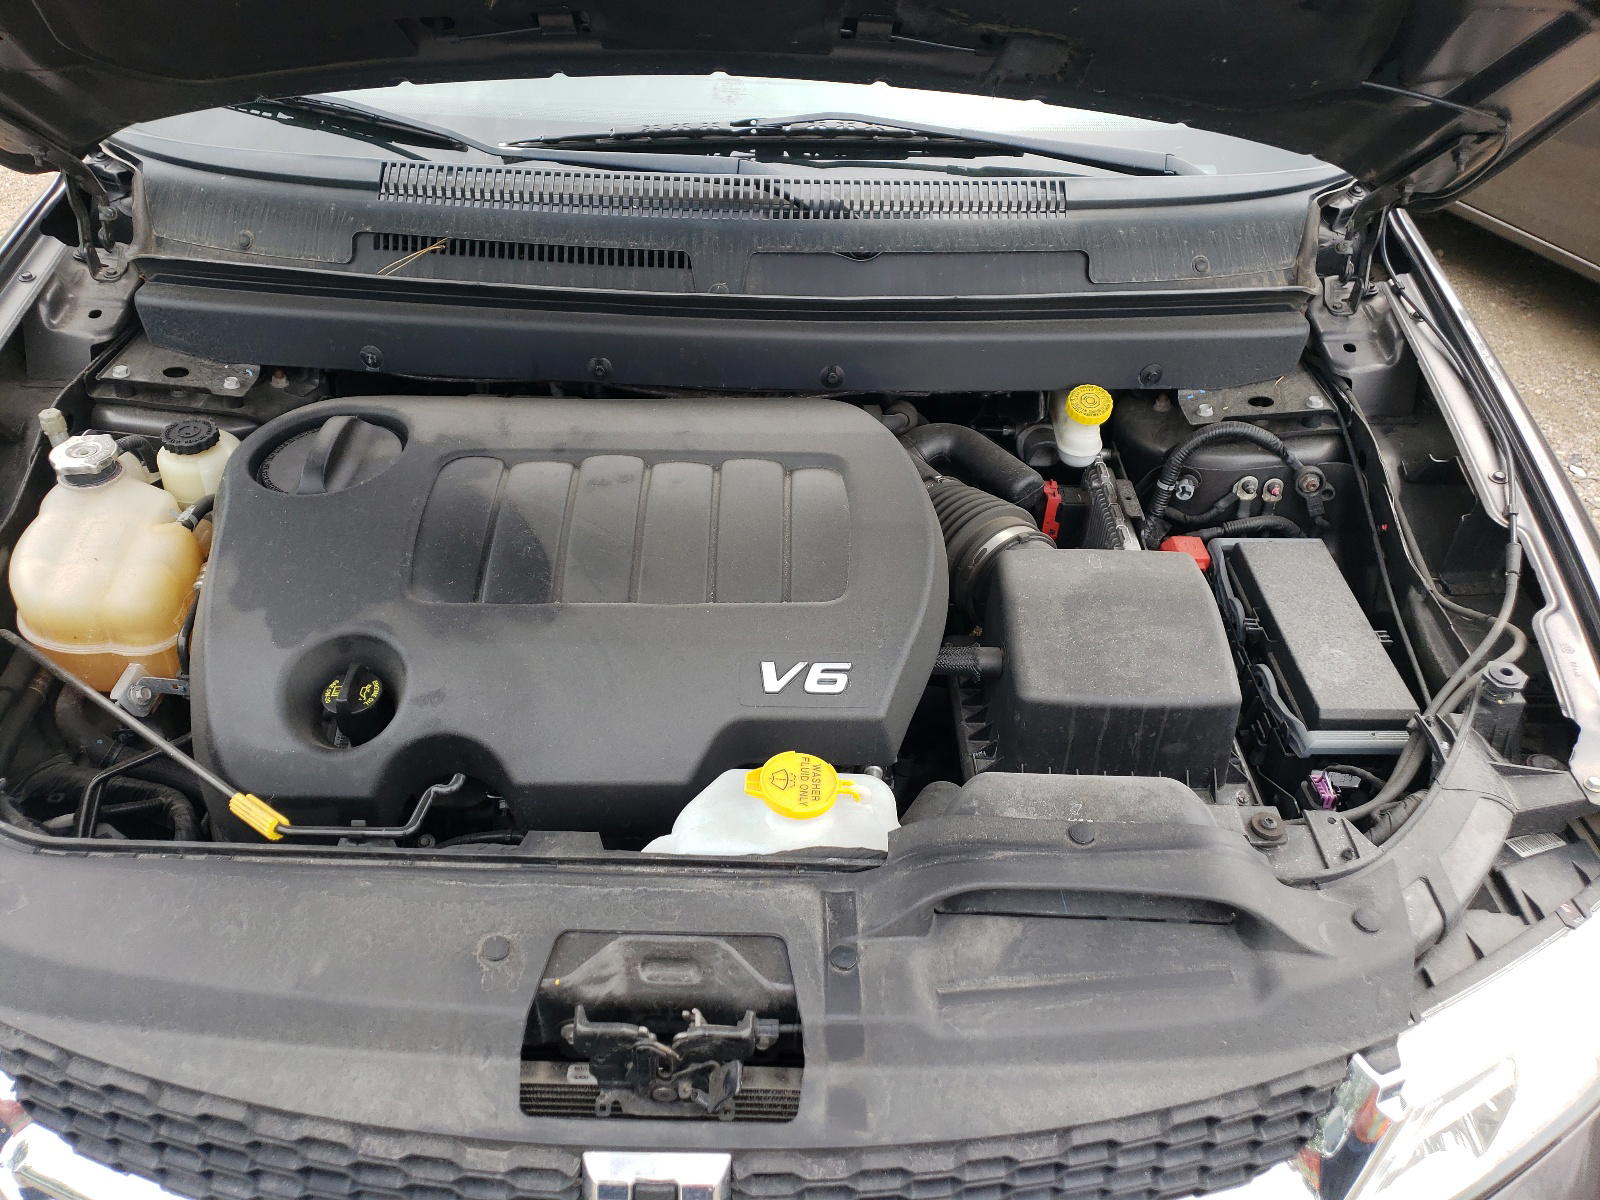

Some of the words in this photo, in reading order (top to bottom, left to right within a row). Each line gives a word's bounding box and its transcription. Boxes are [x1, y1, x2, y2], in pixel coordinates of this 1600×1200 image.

[760, 661, 853, 694] V6
[800, 756, 811, 781] FLUID
[811, 763, 822, 802] WASHER
[799, 784, 809, 807] ONLY
